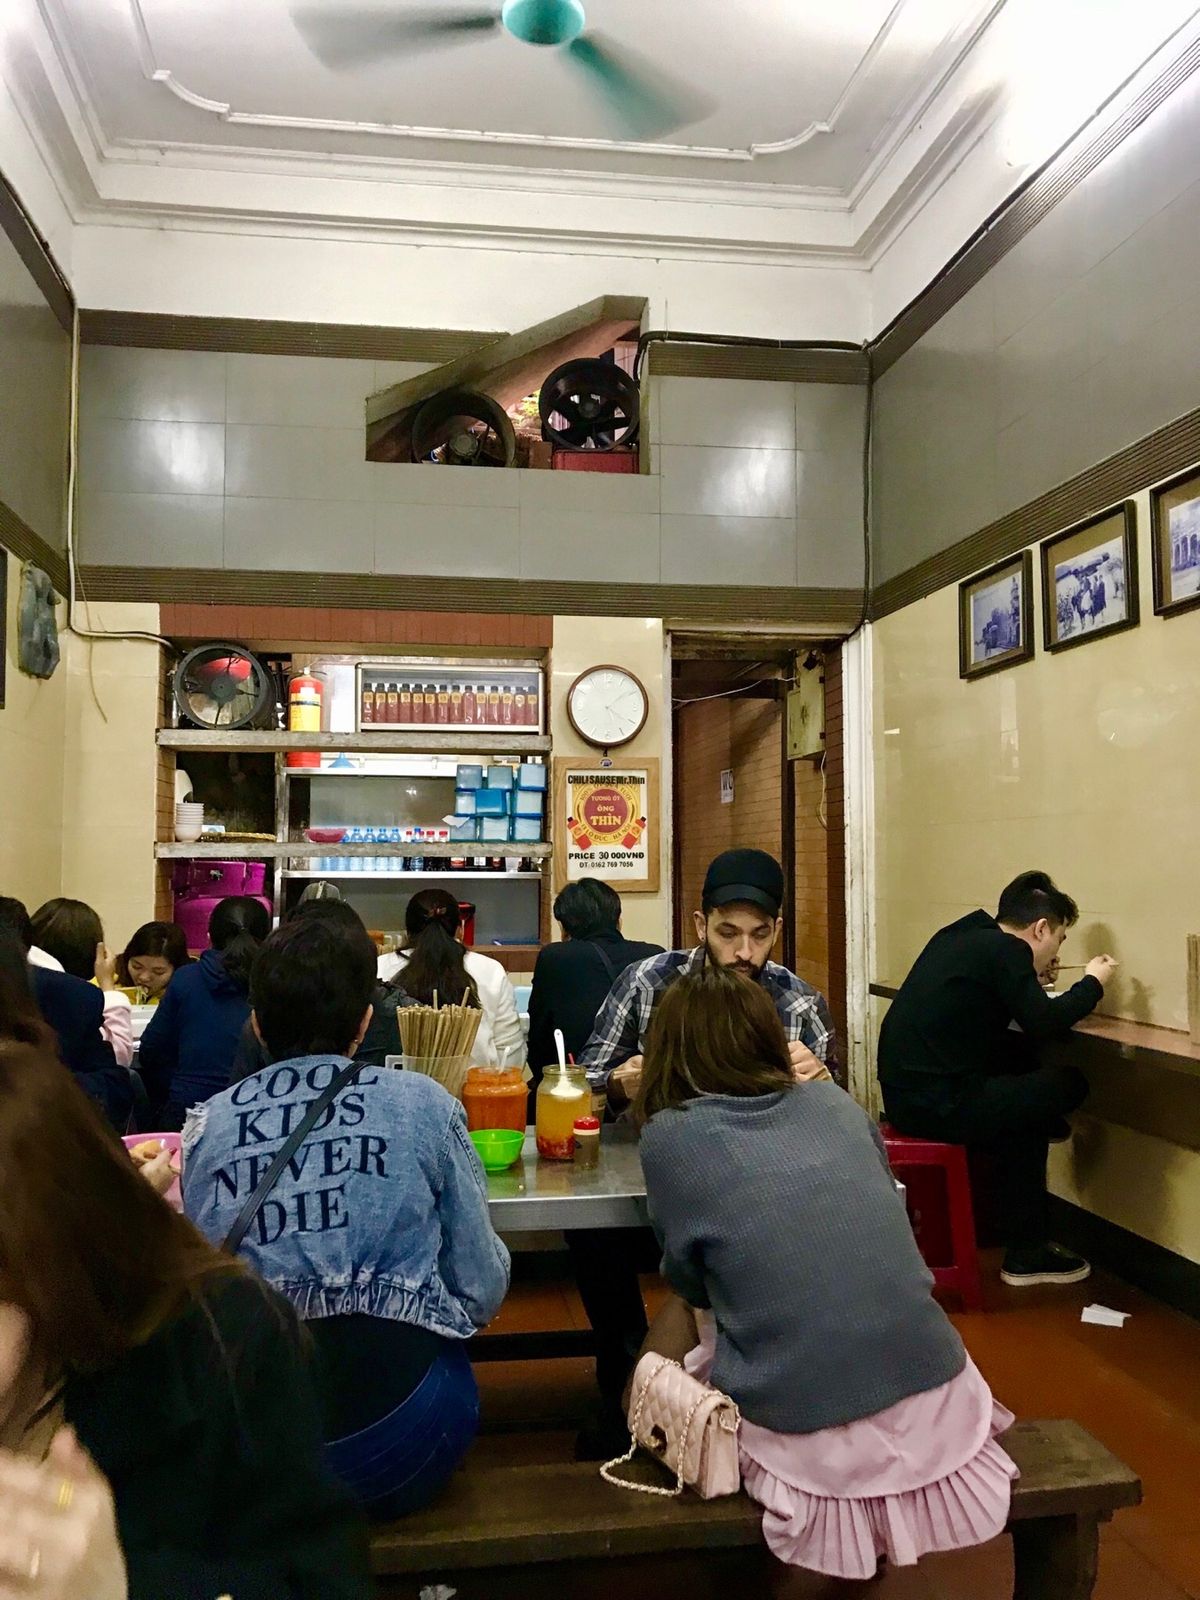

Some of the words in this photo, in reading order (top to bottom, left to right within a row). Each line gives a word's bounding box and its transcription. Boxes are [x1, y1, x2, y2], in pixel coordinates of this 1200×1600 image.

[589, 775, 616, 784] SAUSE
[568, 852, 595, 860] PRICE
[599, 851, 609, 860] 30
[231, 1063, 378, 1106] COOL
[233, 1093, 366, 1149] KIDS
[212, 1135, 389, 1210] NEVER
[256, 1184, 349, 1246] DIE
